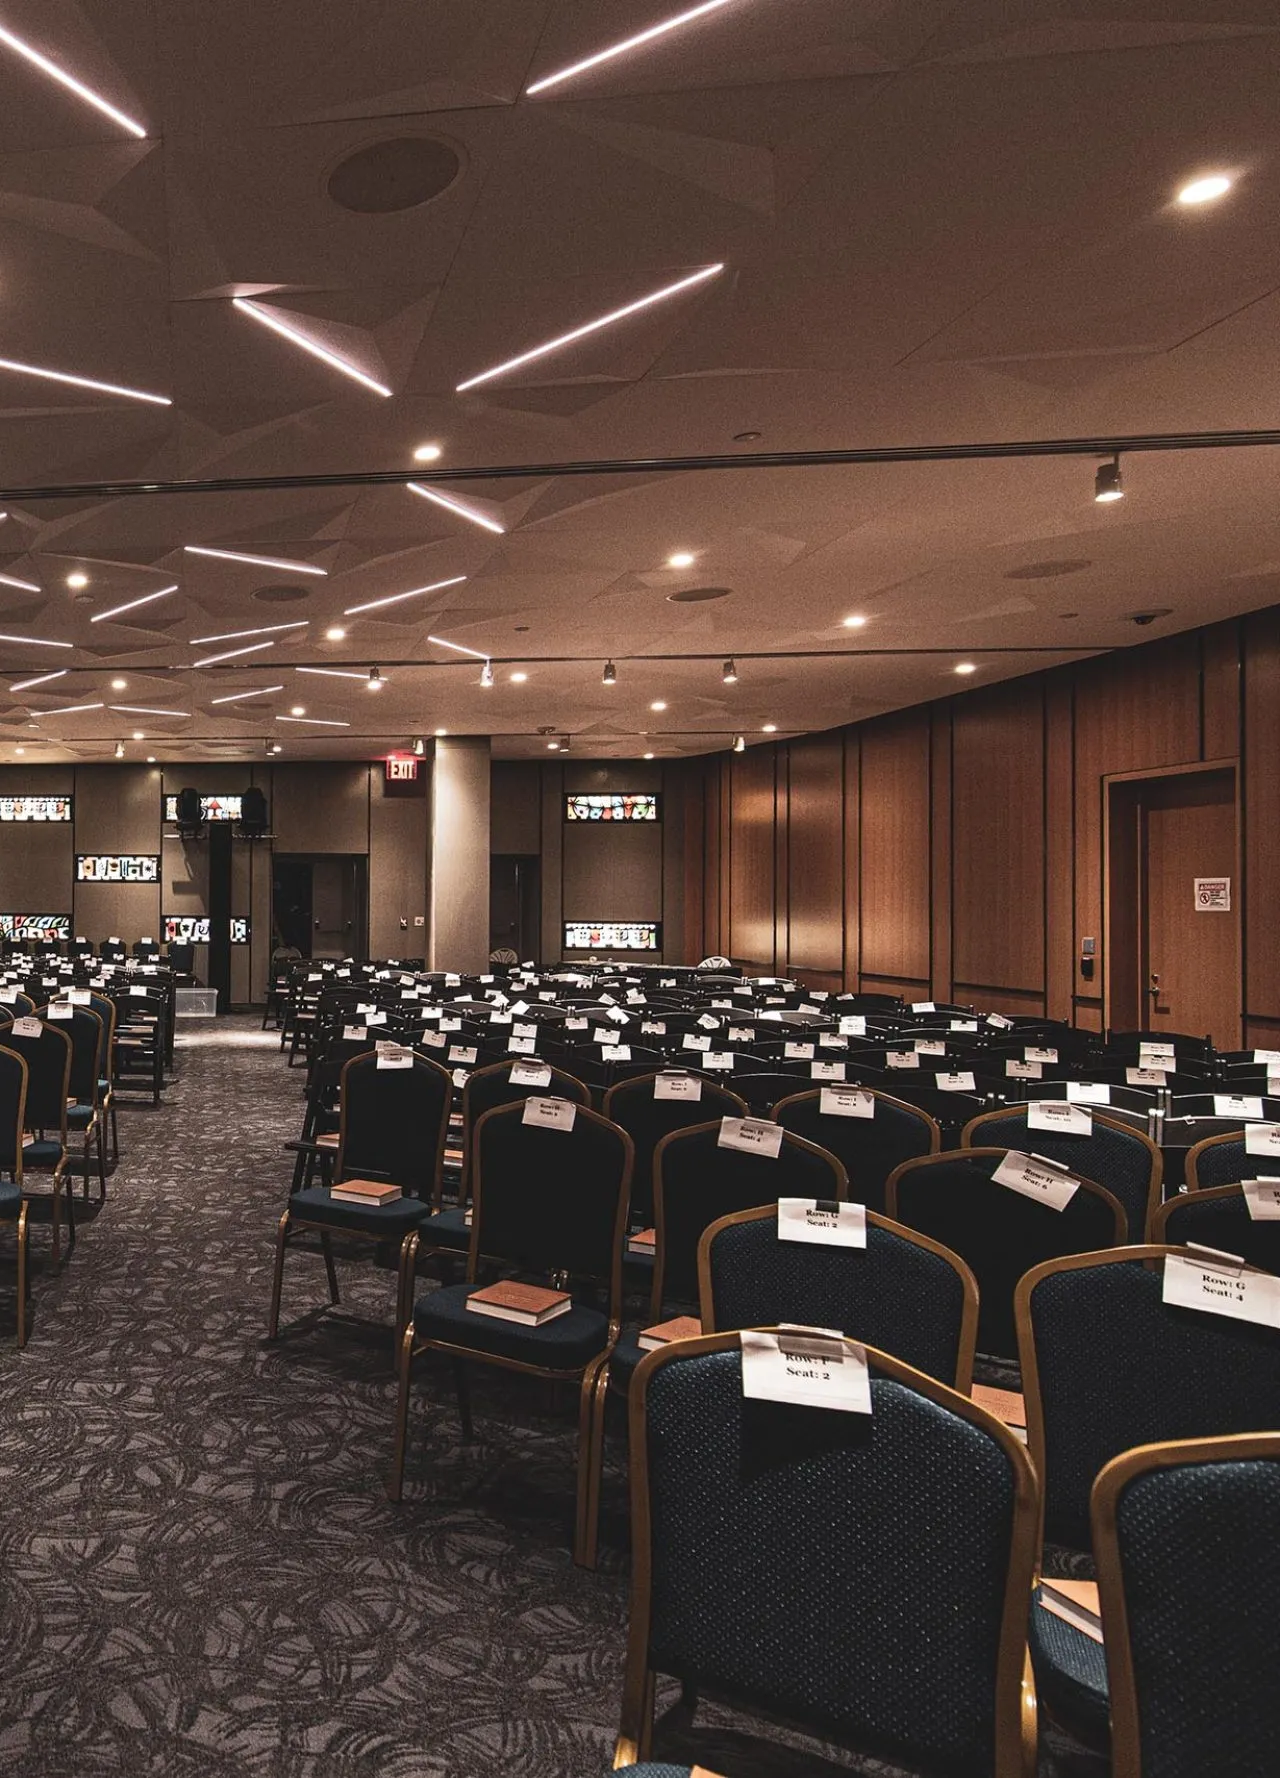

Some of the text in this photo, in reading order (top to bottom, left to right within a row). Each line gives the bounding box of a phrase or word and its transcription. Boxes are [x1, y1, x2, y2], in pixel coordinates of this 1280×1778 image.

[390, 760, 414, 779] EXIT
[1021, 1174, 1041, 1187] Seat:
[1025, 1168, 1045, 1180] Row:
[806, 1209, 829, 1219] Row:
[806, 1219, 829, 1228] Seat:
[1201, 1274, 1246, 1291] Row: G
[1201, 1284, 1243, 1302] Seat: 4
[785, 1353, 818, 1365] Row:
[785, 1367, 831, 1381] Seat: 2
